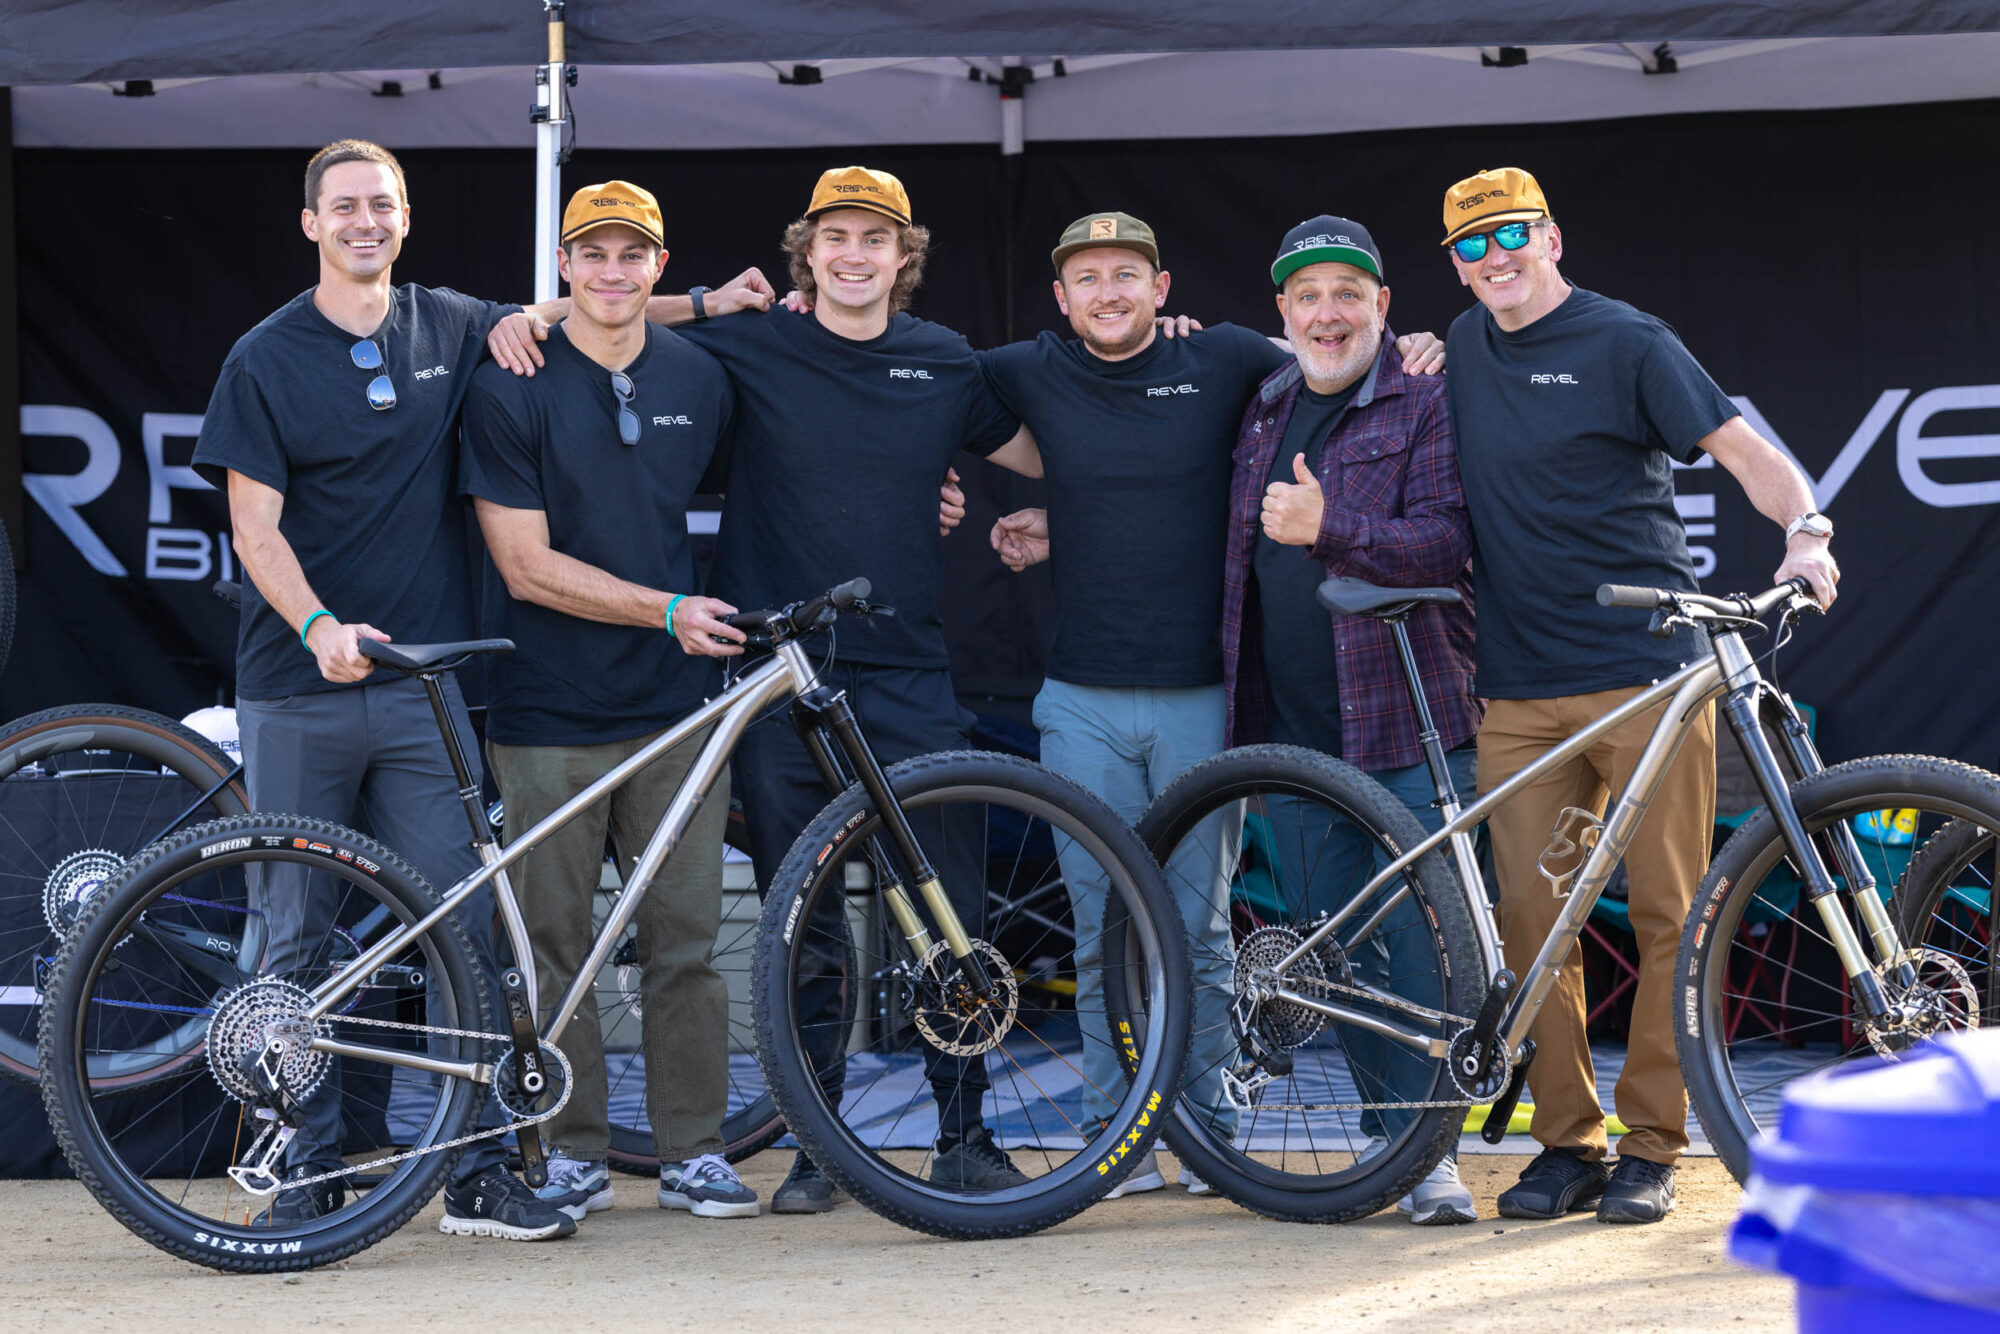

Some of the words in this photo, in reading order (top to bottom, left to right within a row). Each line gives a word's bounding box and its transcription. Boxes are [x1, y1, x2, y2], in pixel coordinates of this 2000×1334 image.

[843, 184, 884, 195] REVEL
[1466, 190, 1511, 205] REVEL
[1305, 234, 1356, 246] REVEL
[414, 365, 449, 381] REVEL
[889, 368, 934, 380] REVEL
[1530, 373, 1579, 384] REVEL
[1147, 383, 1200, 397] REVEL
[653, 415, 693, 426] REVEL
[200, 837, 252, 859] REKON
[1685, 985, 1700, 1038] ASPEN
[1097, 1090, 1162, 1176] MAXXIS
[193, 1232, 302, 1255] MAXXIS
